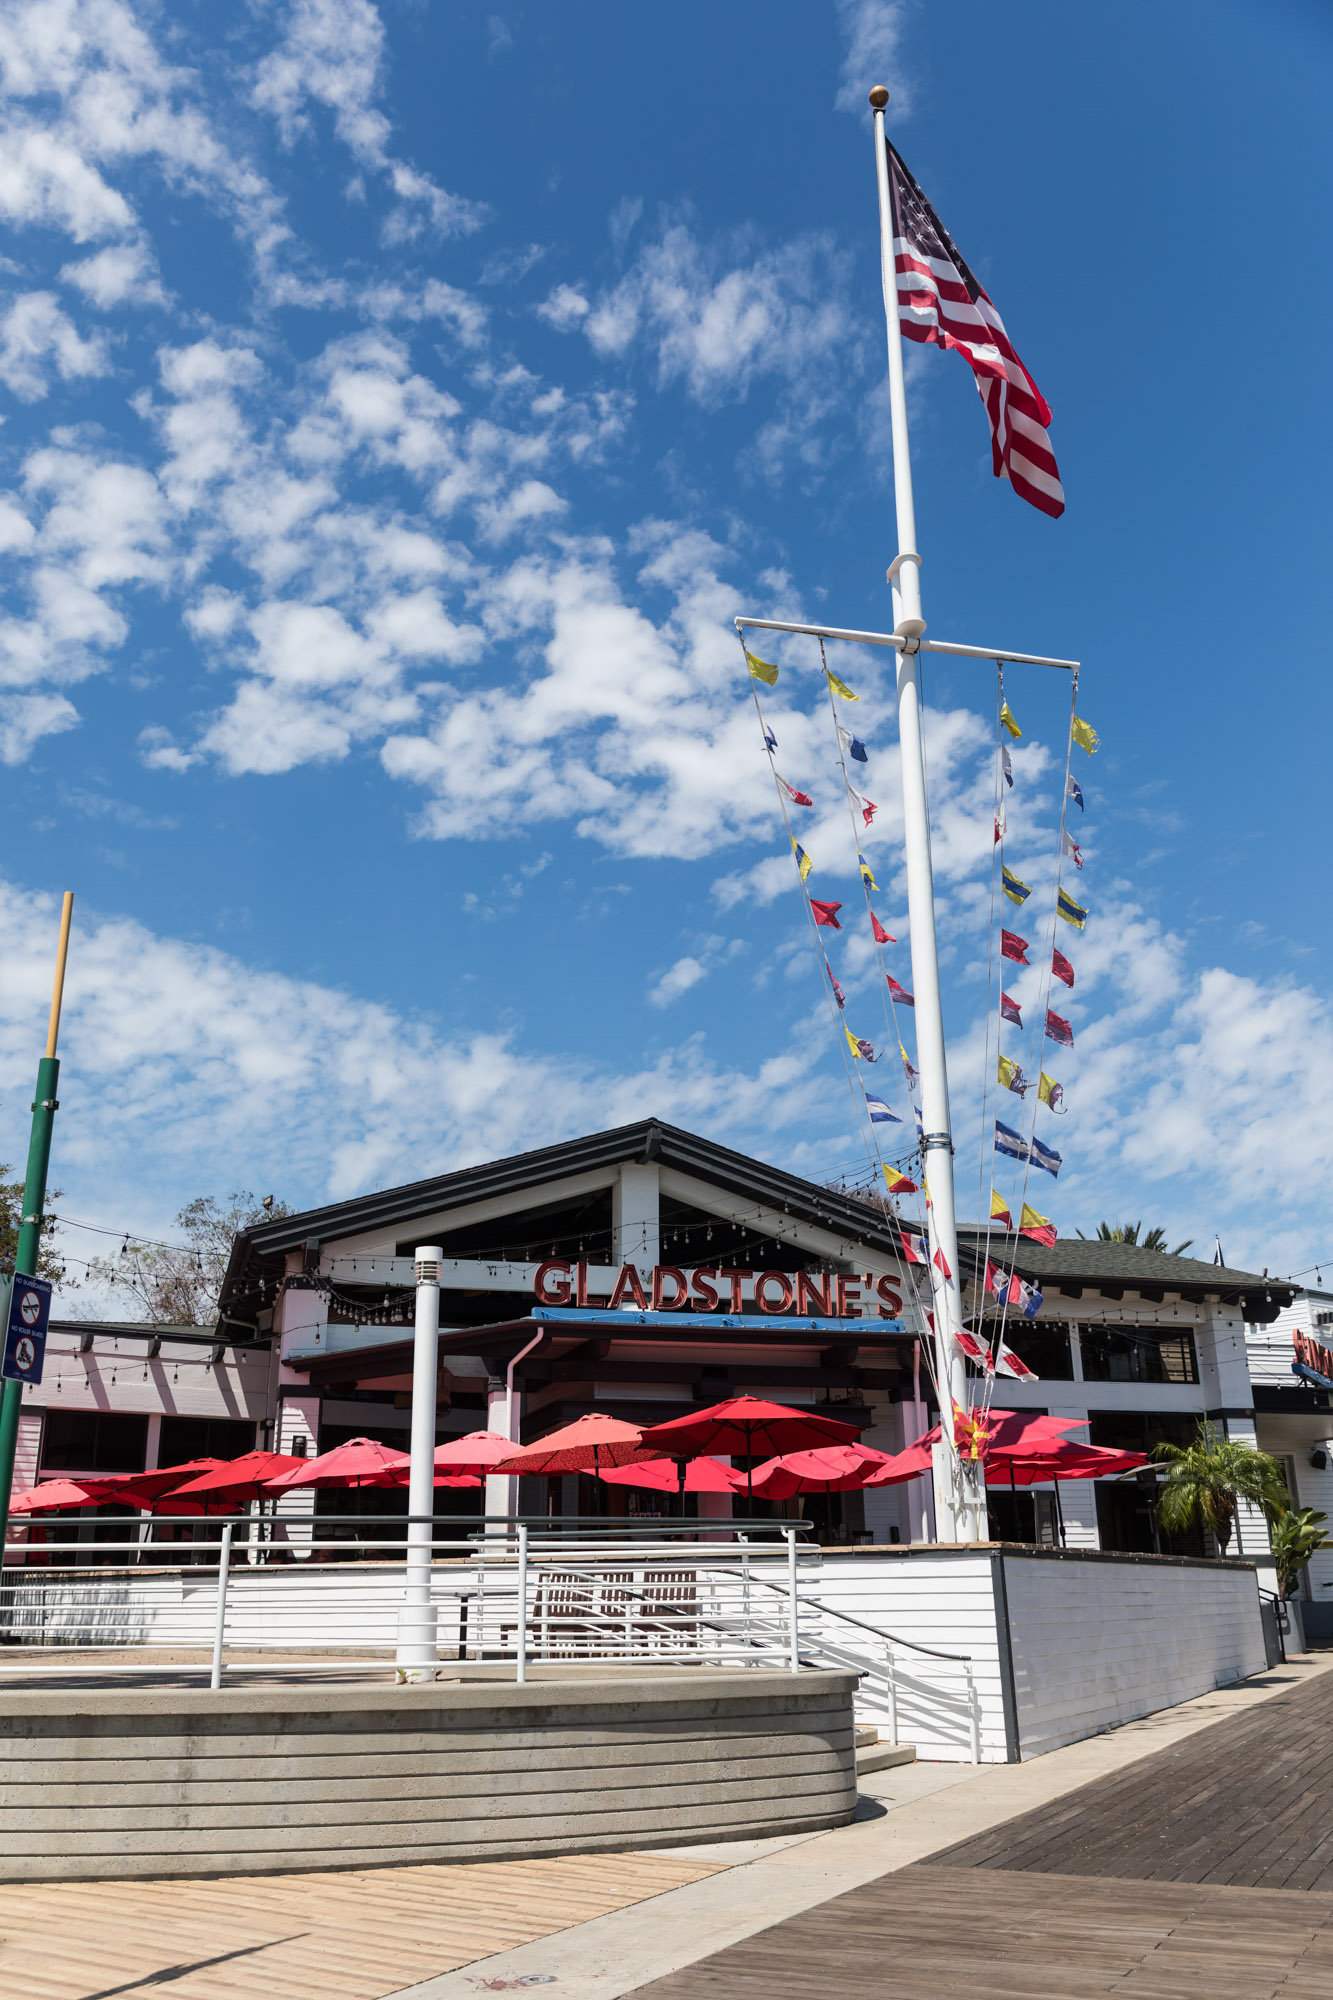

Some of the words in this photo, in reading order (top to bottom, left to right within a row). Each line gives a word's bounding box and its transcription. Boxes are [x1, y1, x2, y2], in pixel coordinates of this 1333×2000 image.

[22, 1279, 51, 1293] SKATEBOARDING
[534, 1259, 903, 1318] GLADSTONE'S
[18, 1327, 31, 1335] ROLLER
[31, 1330, 44, 1339] SKATES
